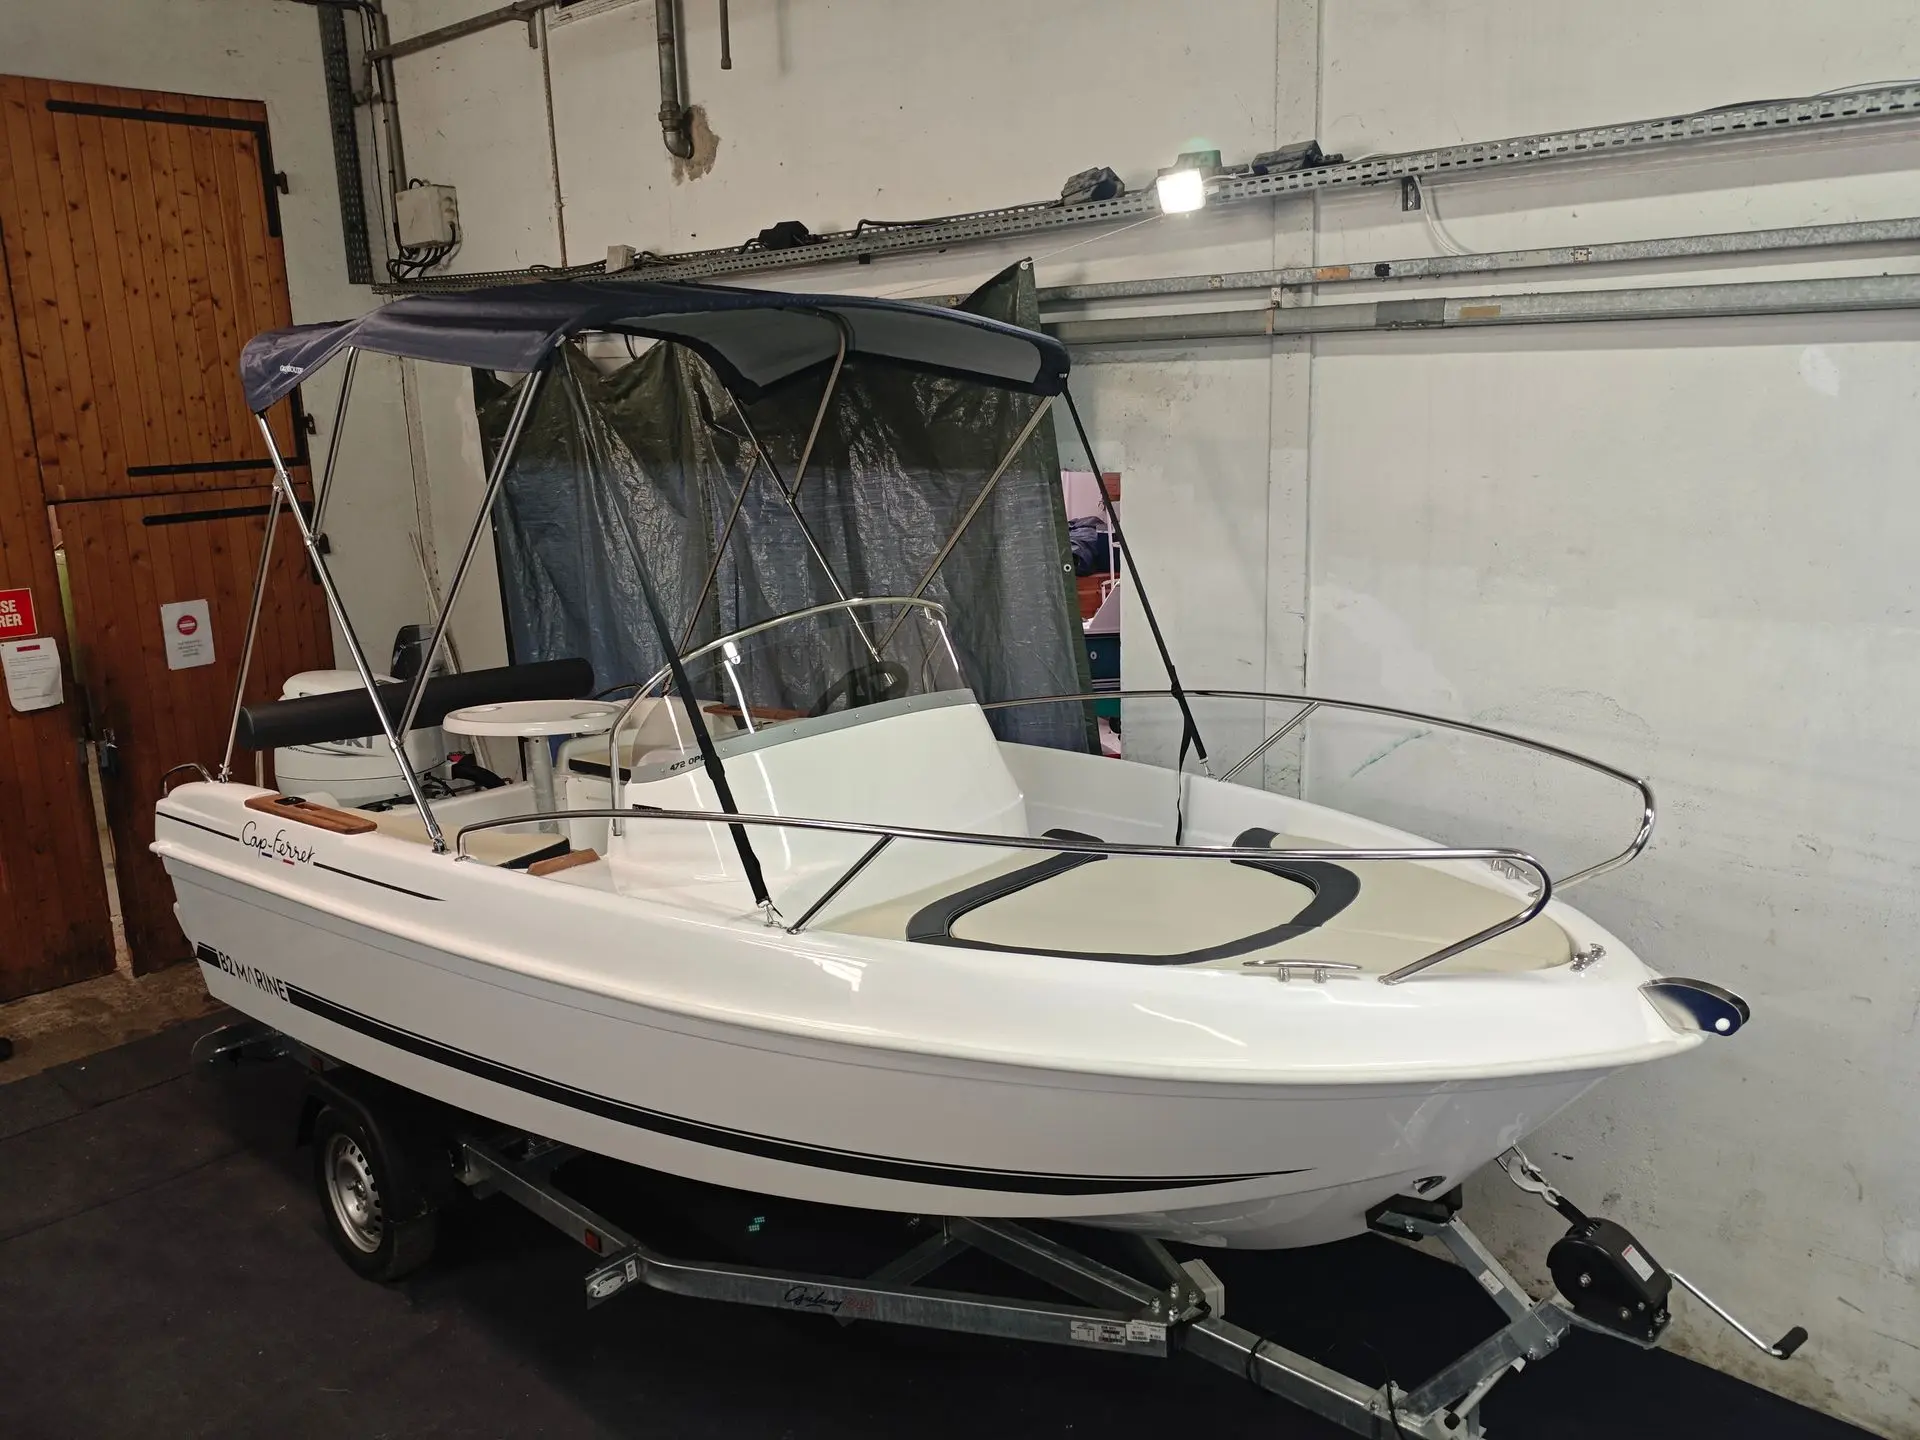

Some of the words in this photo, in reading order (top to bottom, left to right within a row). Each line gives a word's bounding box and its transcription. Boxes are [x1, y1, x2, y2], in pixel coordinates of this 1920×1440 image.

[0, 599, 17, 613] SE
[670, 761, 686, 770] 472
[242, 820, 316, 864] Cap-Ferret
